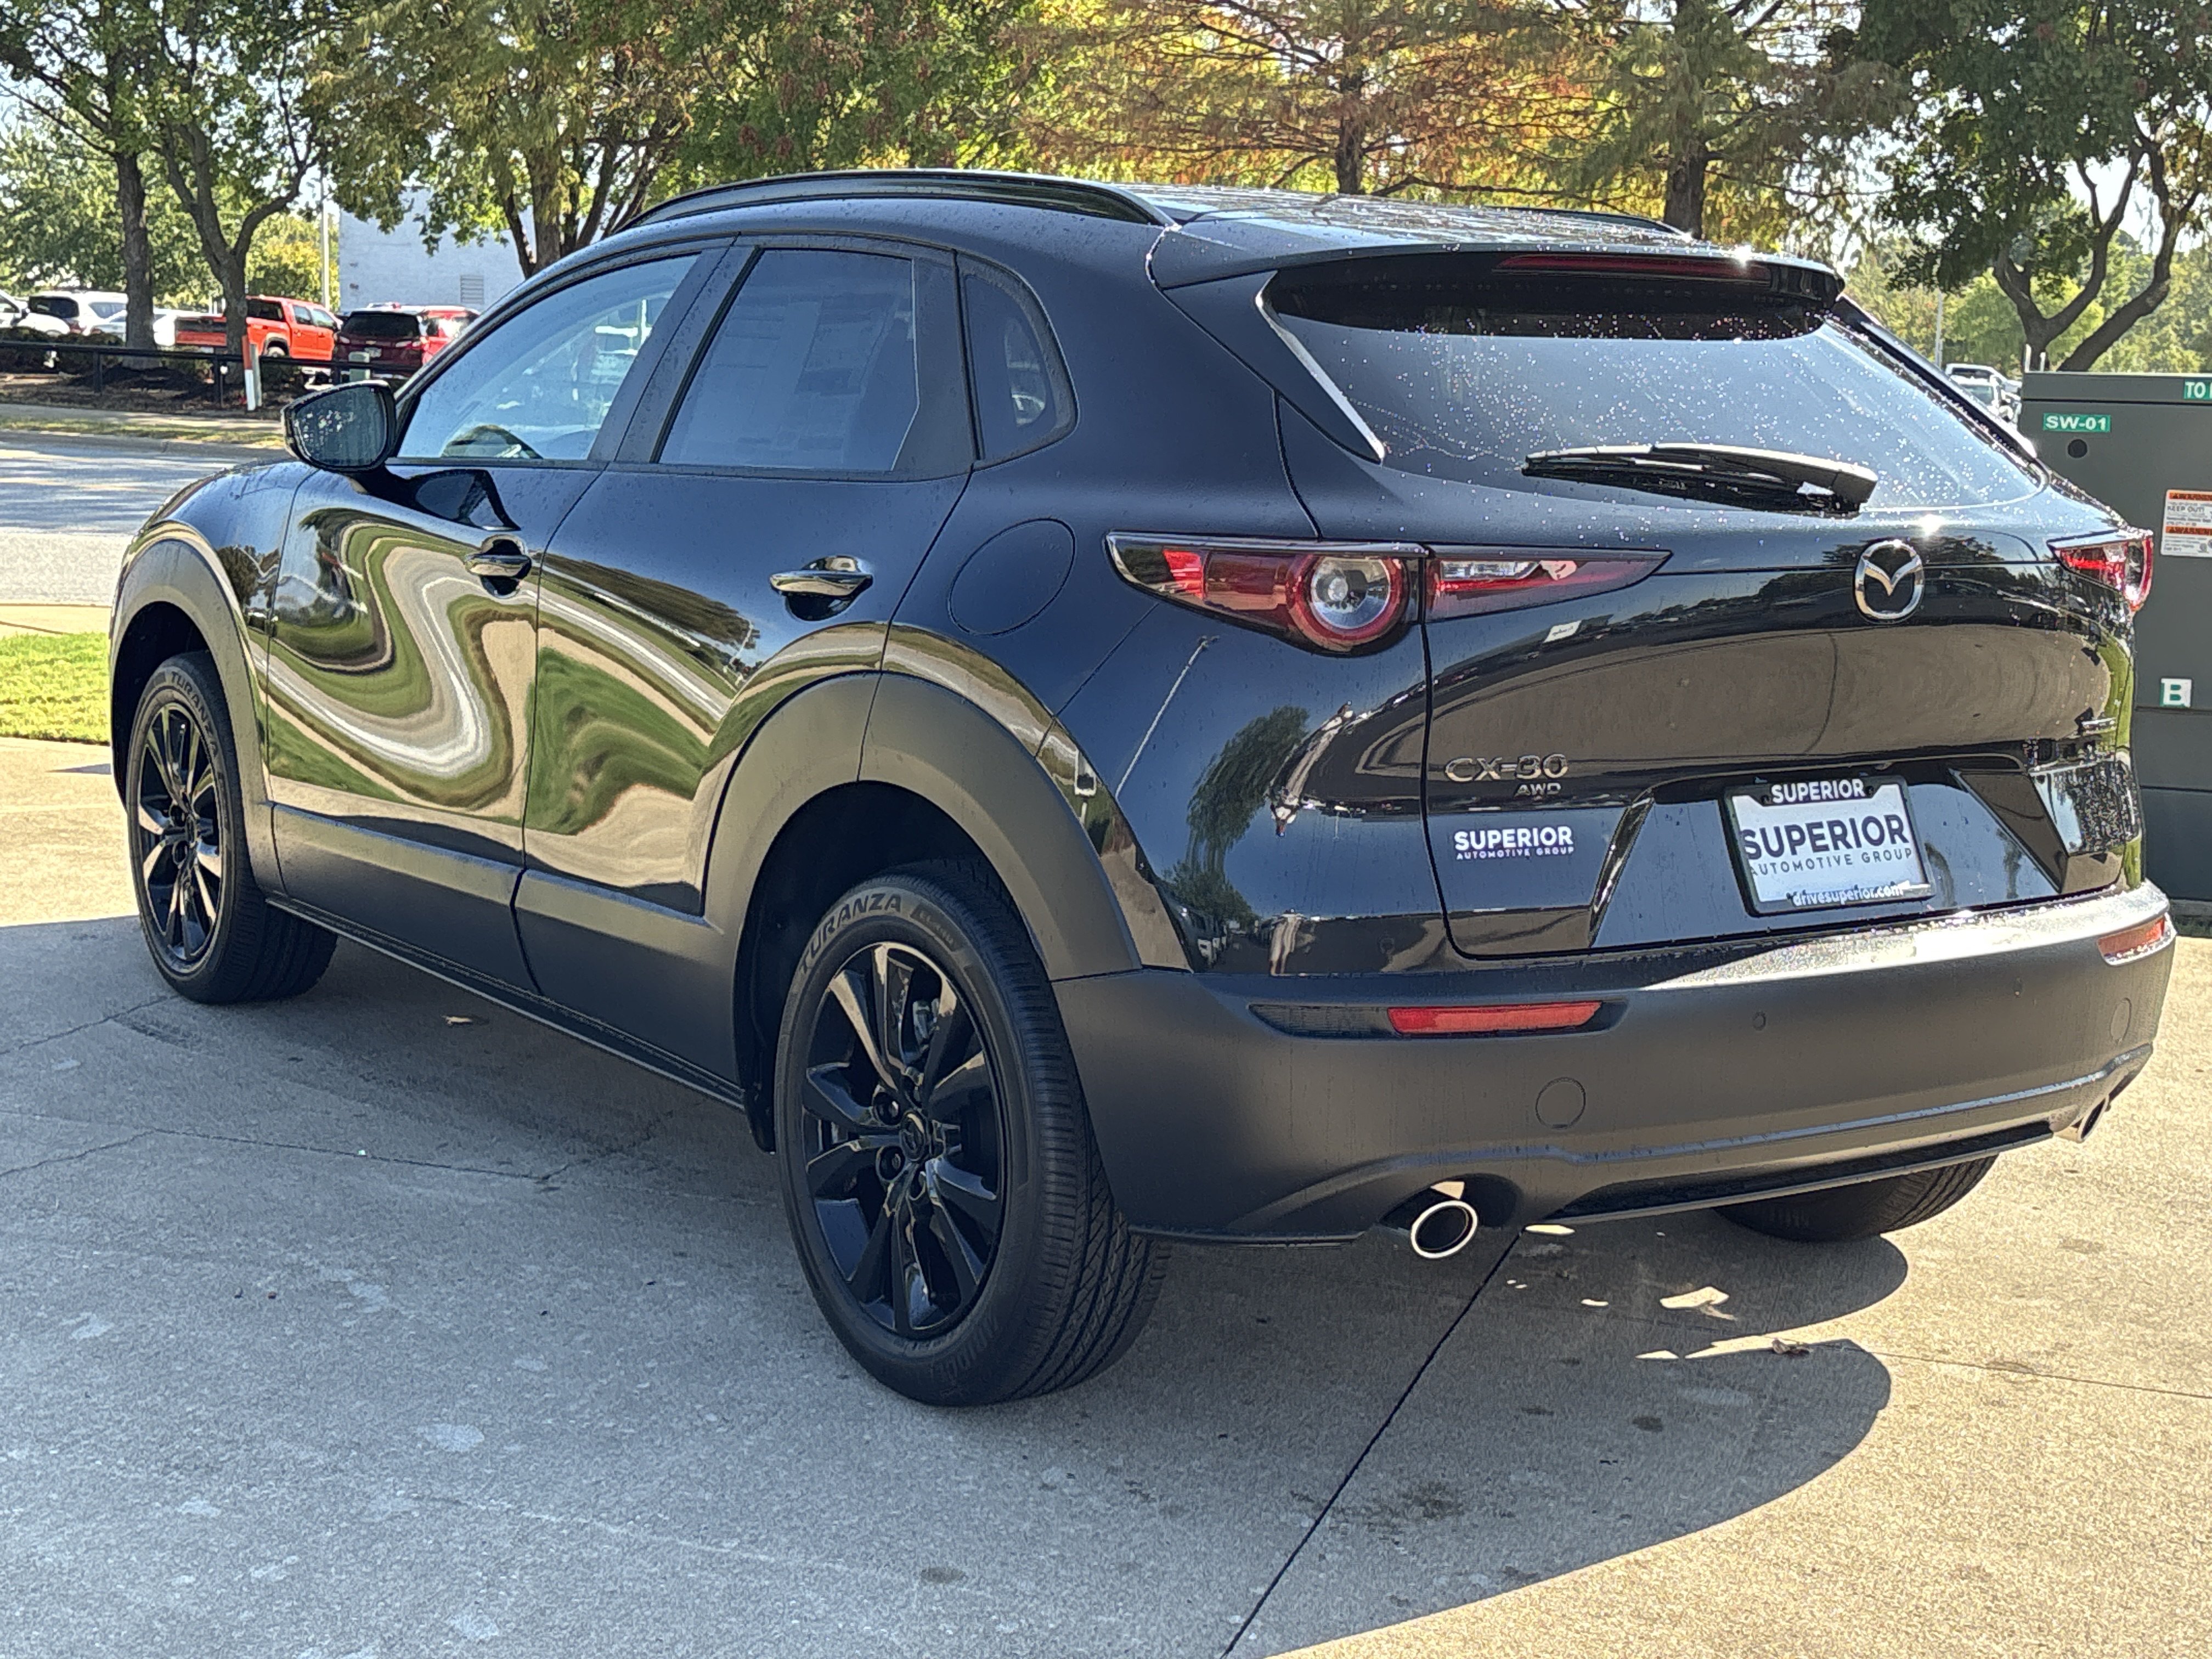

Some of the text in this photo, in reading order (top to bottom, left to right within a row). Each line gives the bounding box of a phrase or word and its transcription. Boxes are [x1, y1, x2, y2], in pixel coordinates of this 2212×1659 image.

[2185, 381, 2206, 399] TO
[2045, 416, 2106, 431] SW-01
[2163, 679, 2188, 706] B
[171, 671, 218, 758] TURANZA
[1444, 753, 1568, 782] CX-30
[1514, 782, 1561, 797] AWD
[1771, 778, 1865, 803] SUPERIOR
[1454, 826, 1573, 850] SUPERIOR
[1739, 814, 1909, 860] SUPERIOR
[1456, 847, 1575, 860] AUTOMOTIVE GROUP
[1861, 847, 1912, 864] GROUP
[1793, 884, 1905, 906] drivesuperior.com
[798, 893, 901, 974] TURANZA
